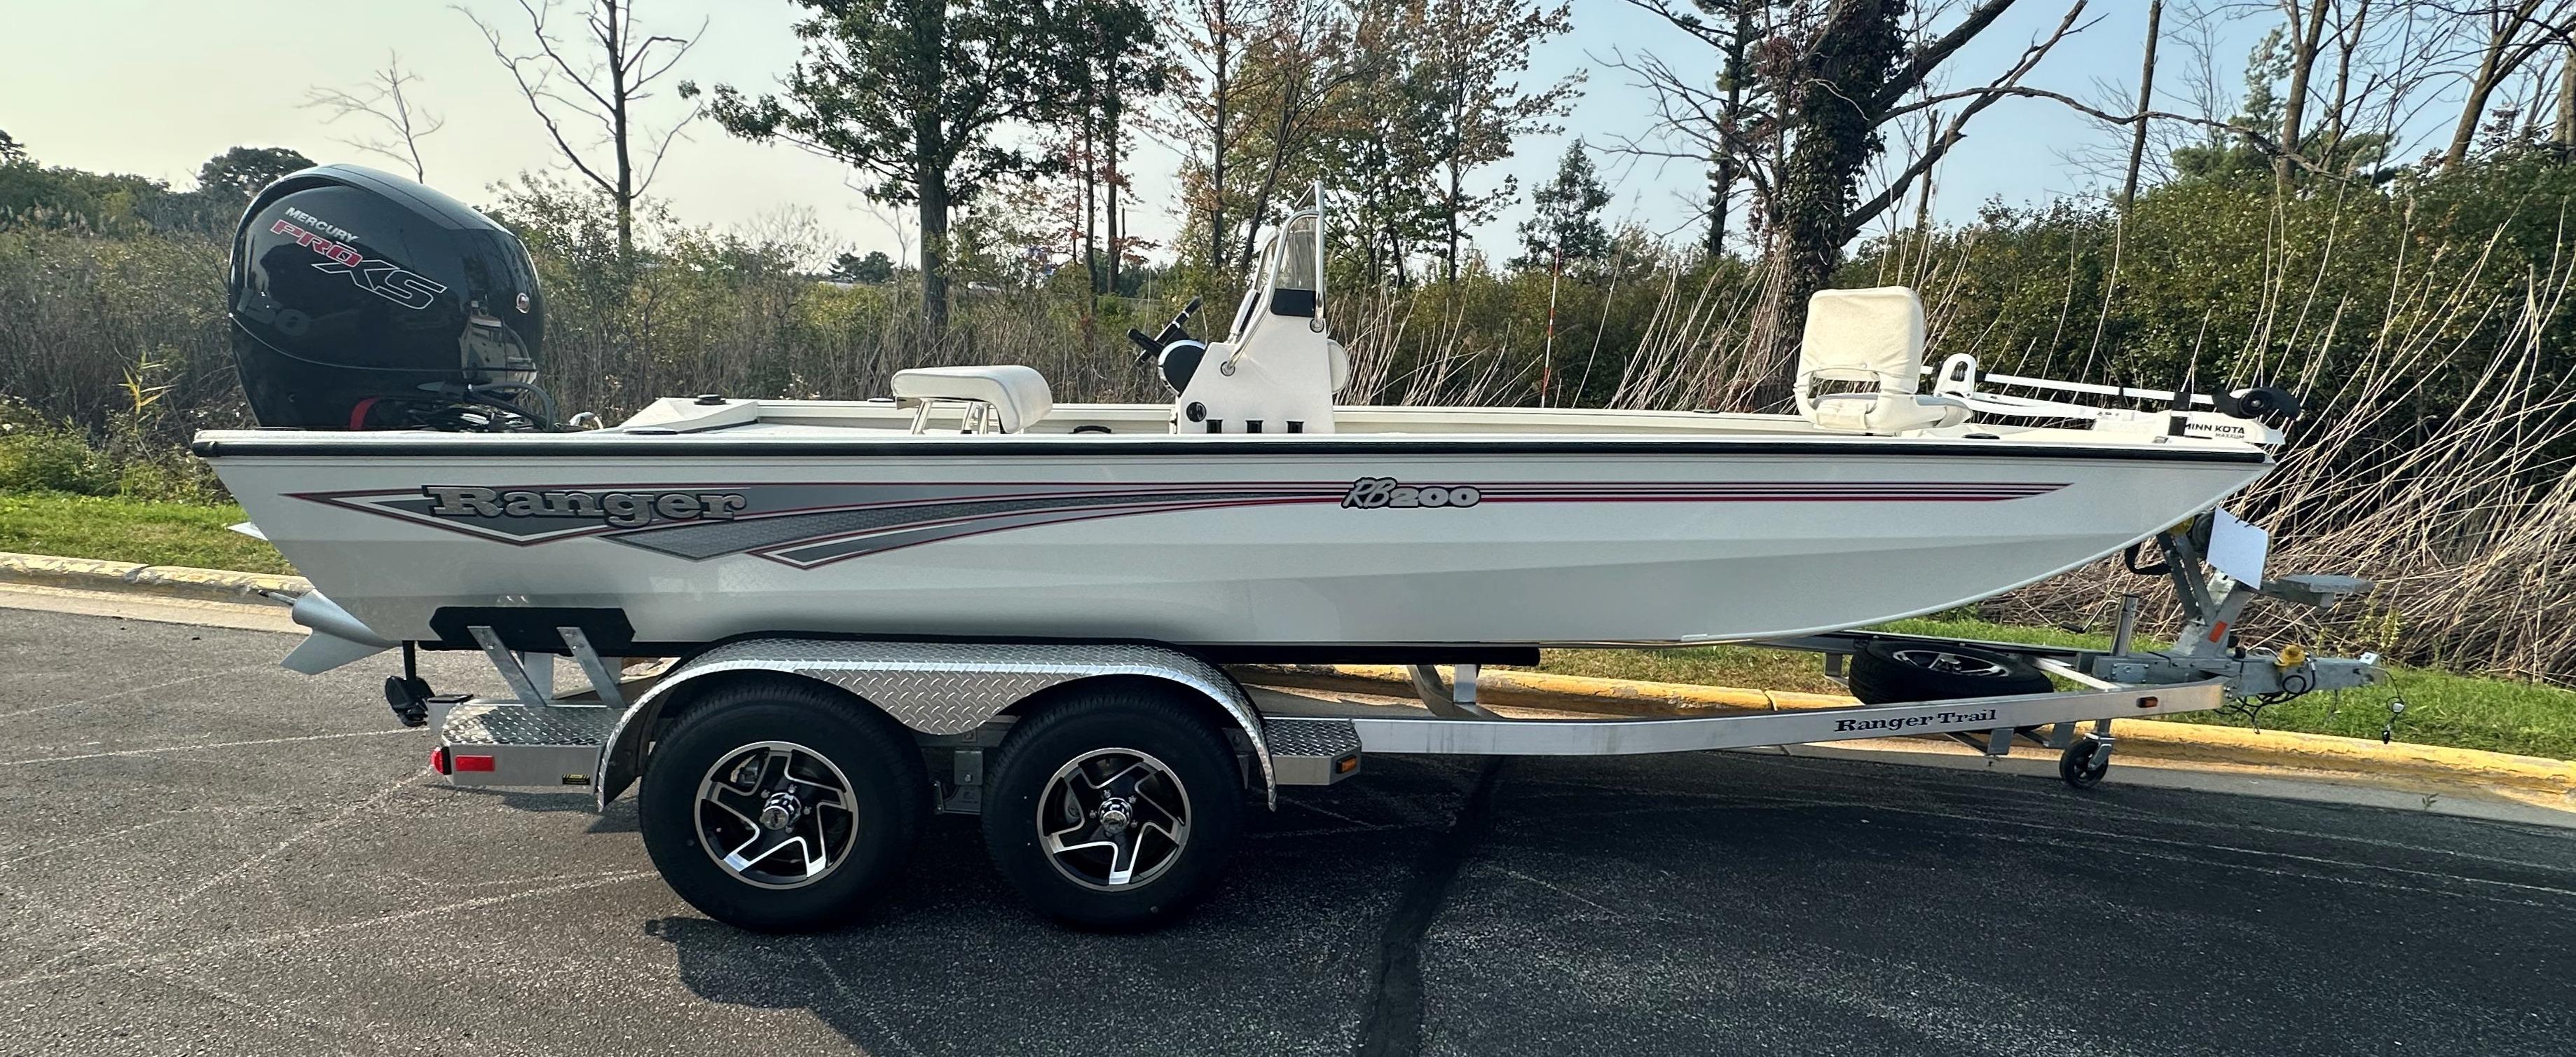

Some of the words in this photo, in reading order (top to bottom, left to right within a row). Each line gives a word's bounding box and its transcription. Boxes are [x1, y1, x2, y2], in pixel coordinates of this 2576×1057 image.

[270, 219, 363, 268] PRO
[285, 207, 359, 243] MERCURY
[311, 259, 448, 310] XS
[2214, 425, 2245, 434] KOTA
[421, 485, 747, 528] Ranger
[1834, 715, 1933, 732] Ranger
[1937, 709, 1996, 723] Trail
